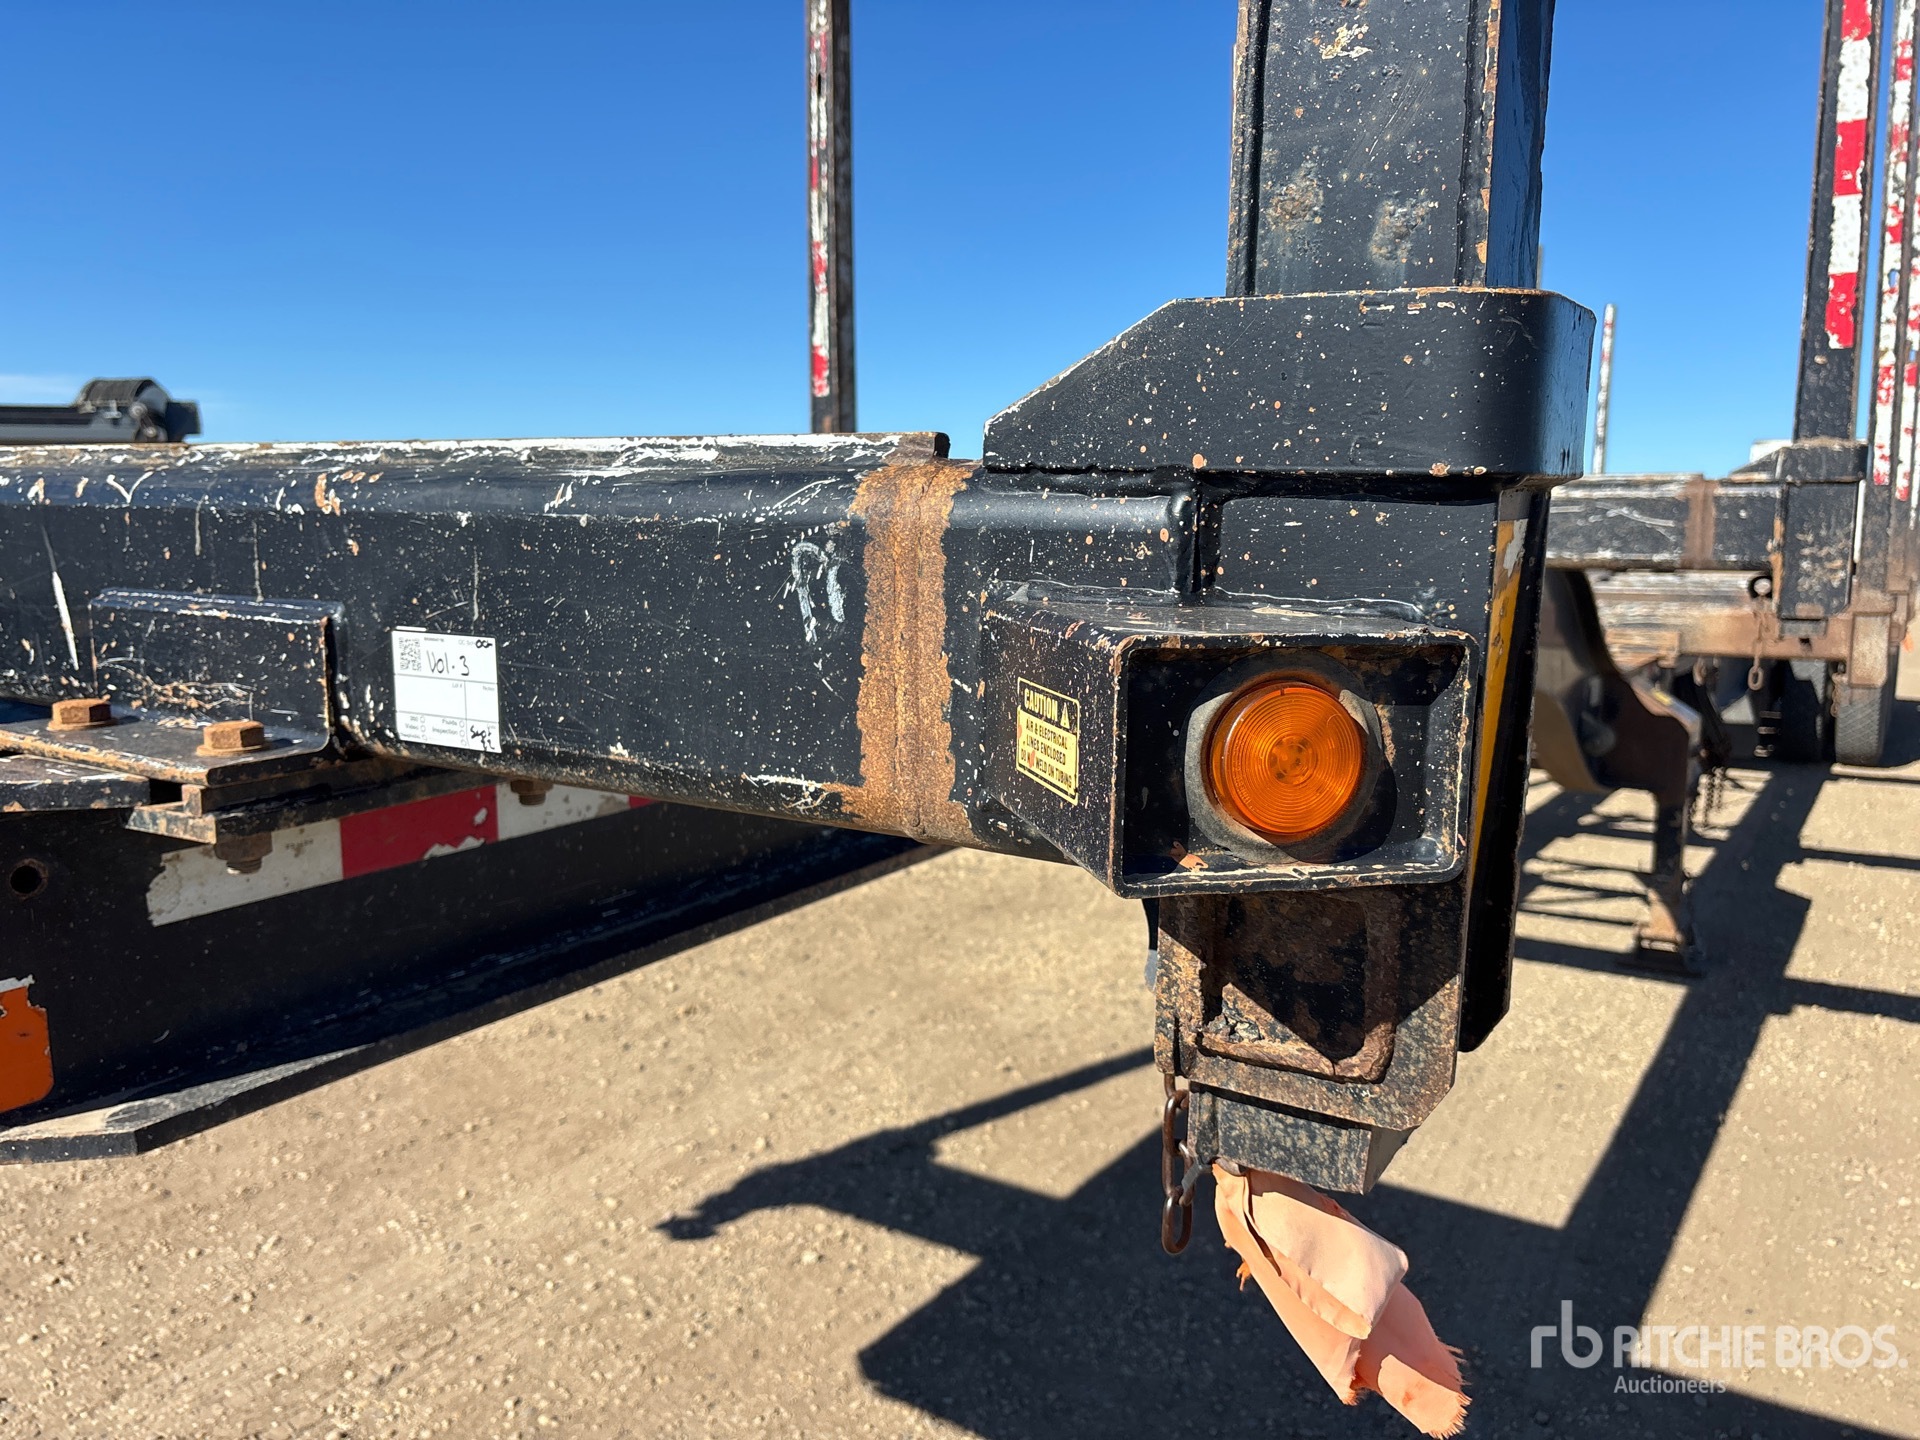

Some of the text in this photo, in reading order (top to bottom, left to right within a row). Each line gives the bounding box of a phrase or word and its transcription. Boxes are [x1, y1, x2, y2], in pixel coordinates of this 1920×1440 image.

[1024, 687, 1058, 722] CAUTION
[1026, 734, 1039, 751] LINES
[1040, 741, 1066, 766] ENCLOSED
[1039, 724, 1068, 750] ELECTRICAL
[1035, 756, 1047, 774] WELD
[1048, 763, 1055, 778] ON
[1055, 768, 1072, 788] TUBING
